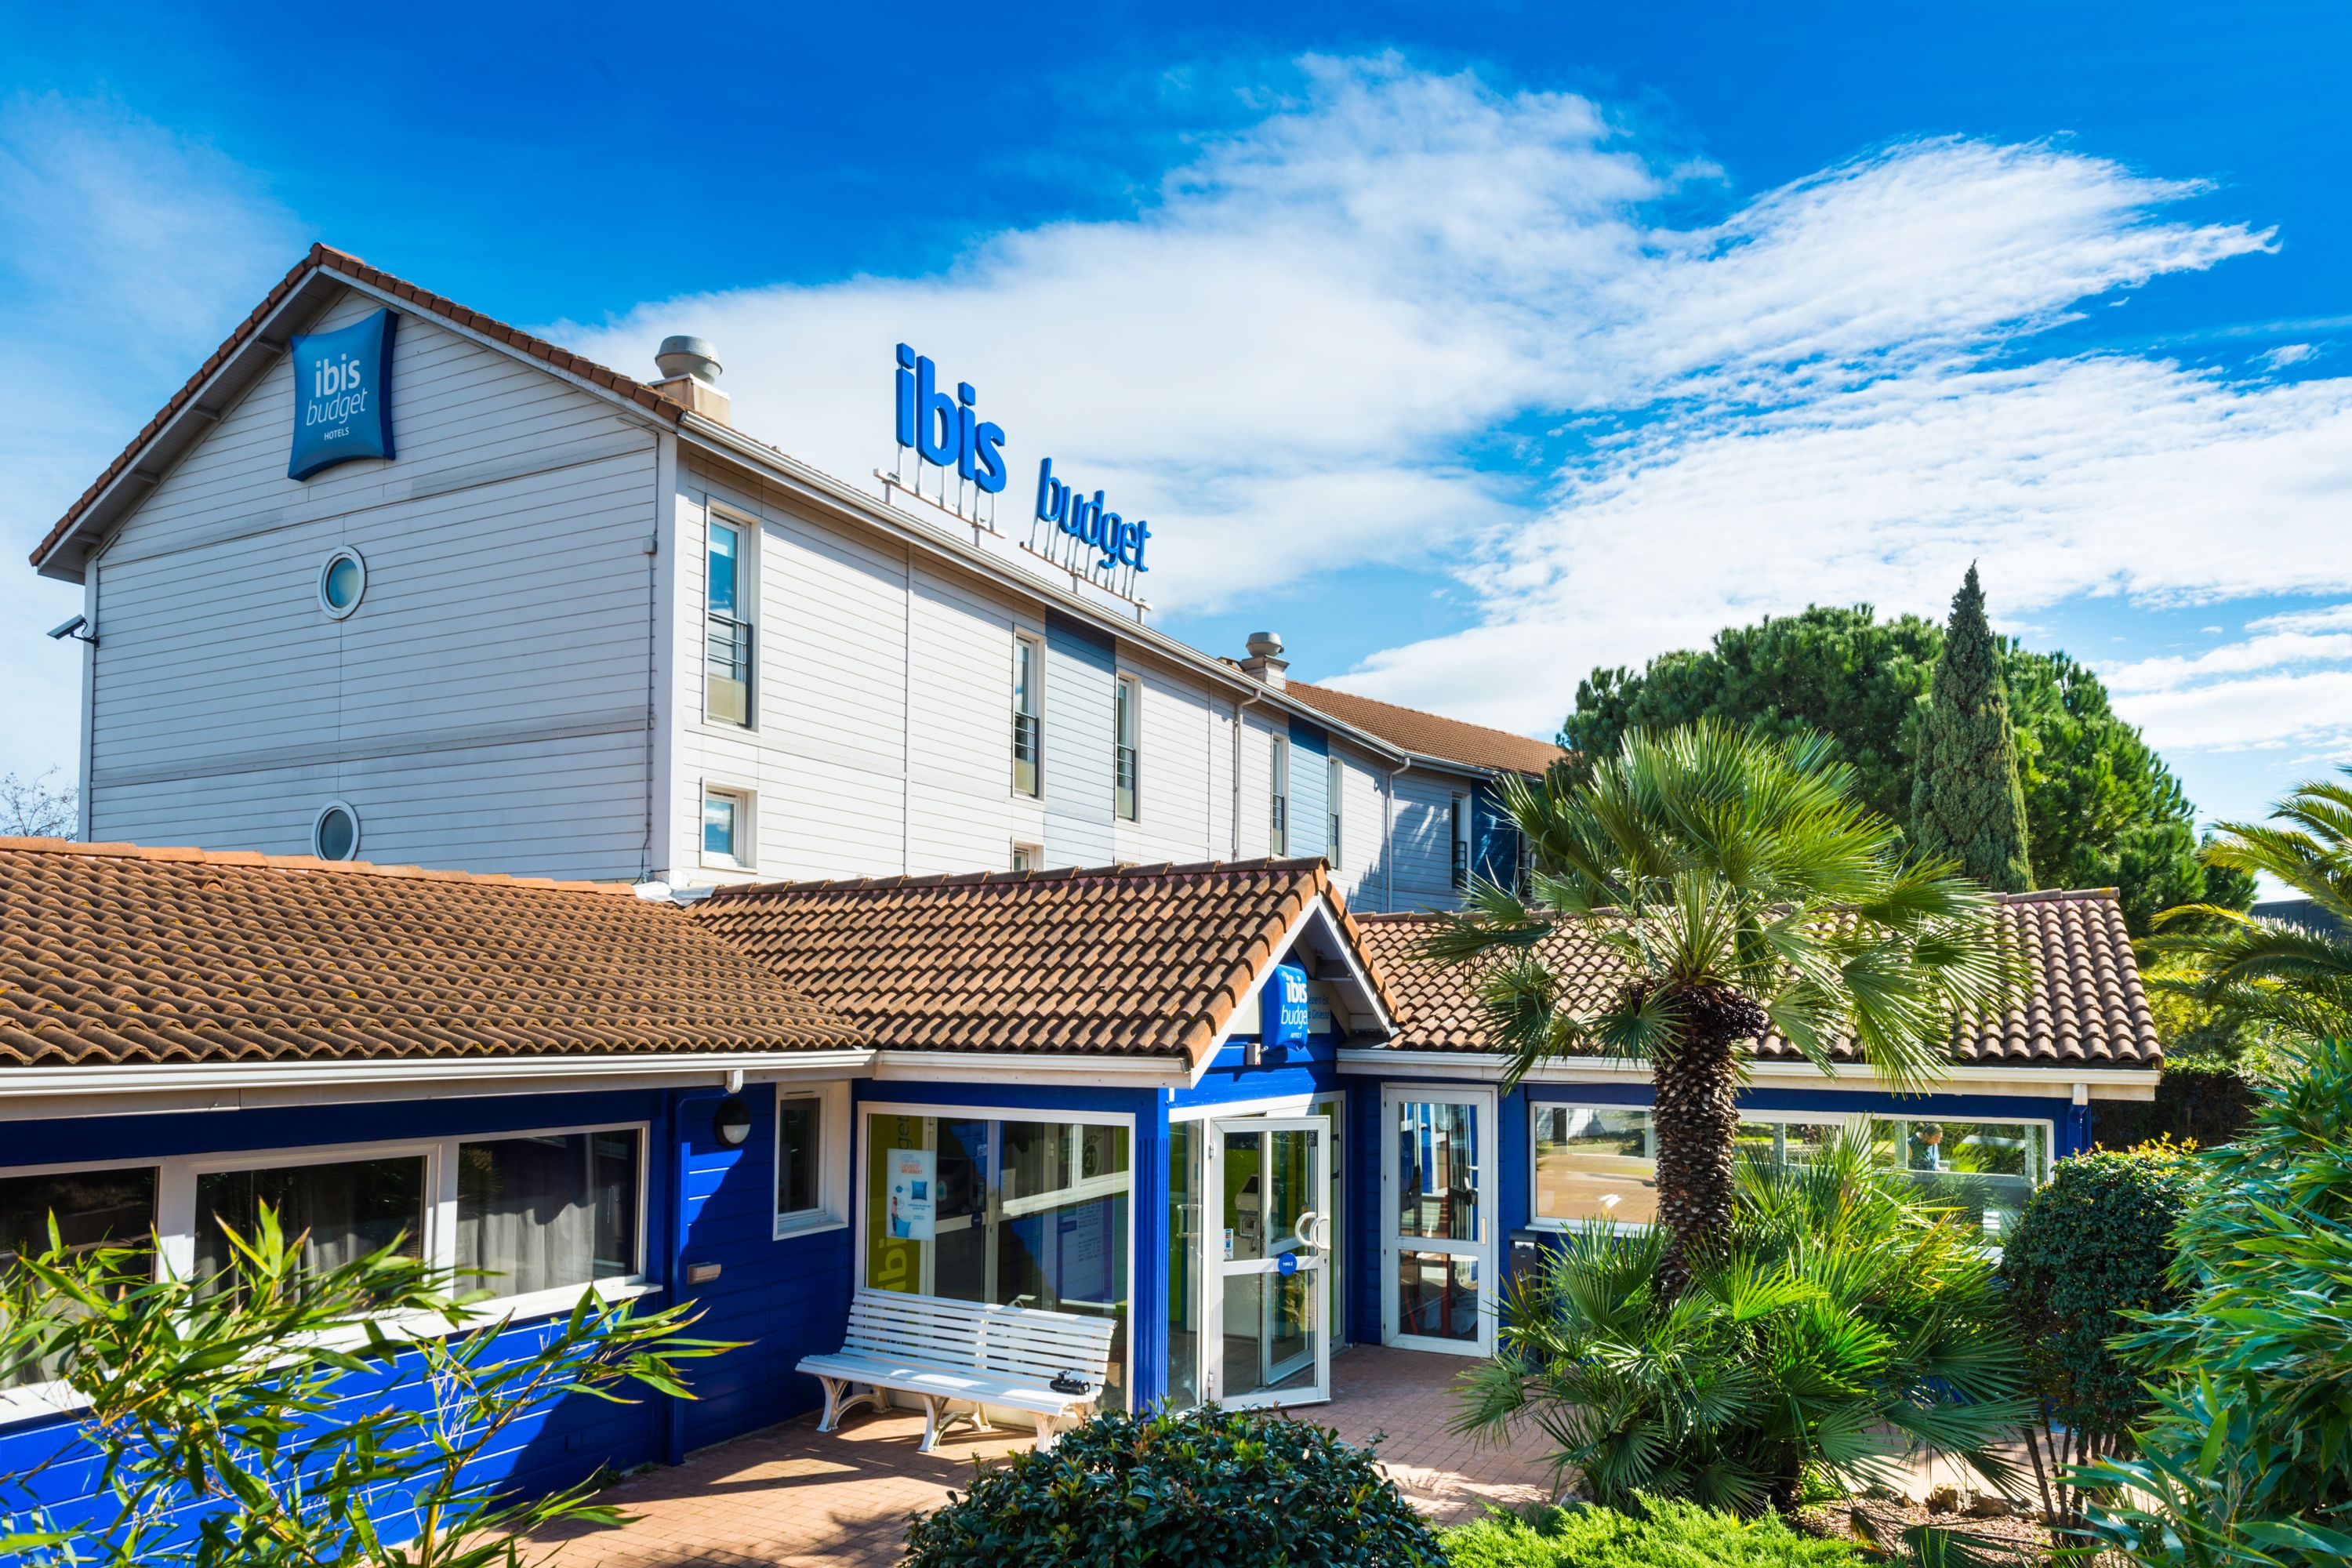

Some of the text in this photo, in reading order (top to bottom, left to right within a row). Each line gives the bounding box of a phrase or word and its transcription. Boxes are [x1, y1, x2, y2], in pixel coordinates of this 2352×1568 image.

[315, 354, 361, 397] ibis
[307, 387, 368, 426] budget
[324, 426, 350, 441] HOTELS
[896, 343, 1152, 572] ibis budget
[1286, 975, 1308, 1004] ibis
[1281, 1004, 1308, 1029] budge
[878, 1239, 907, 1292] ibi
